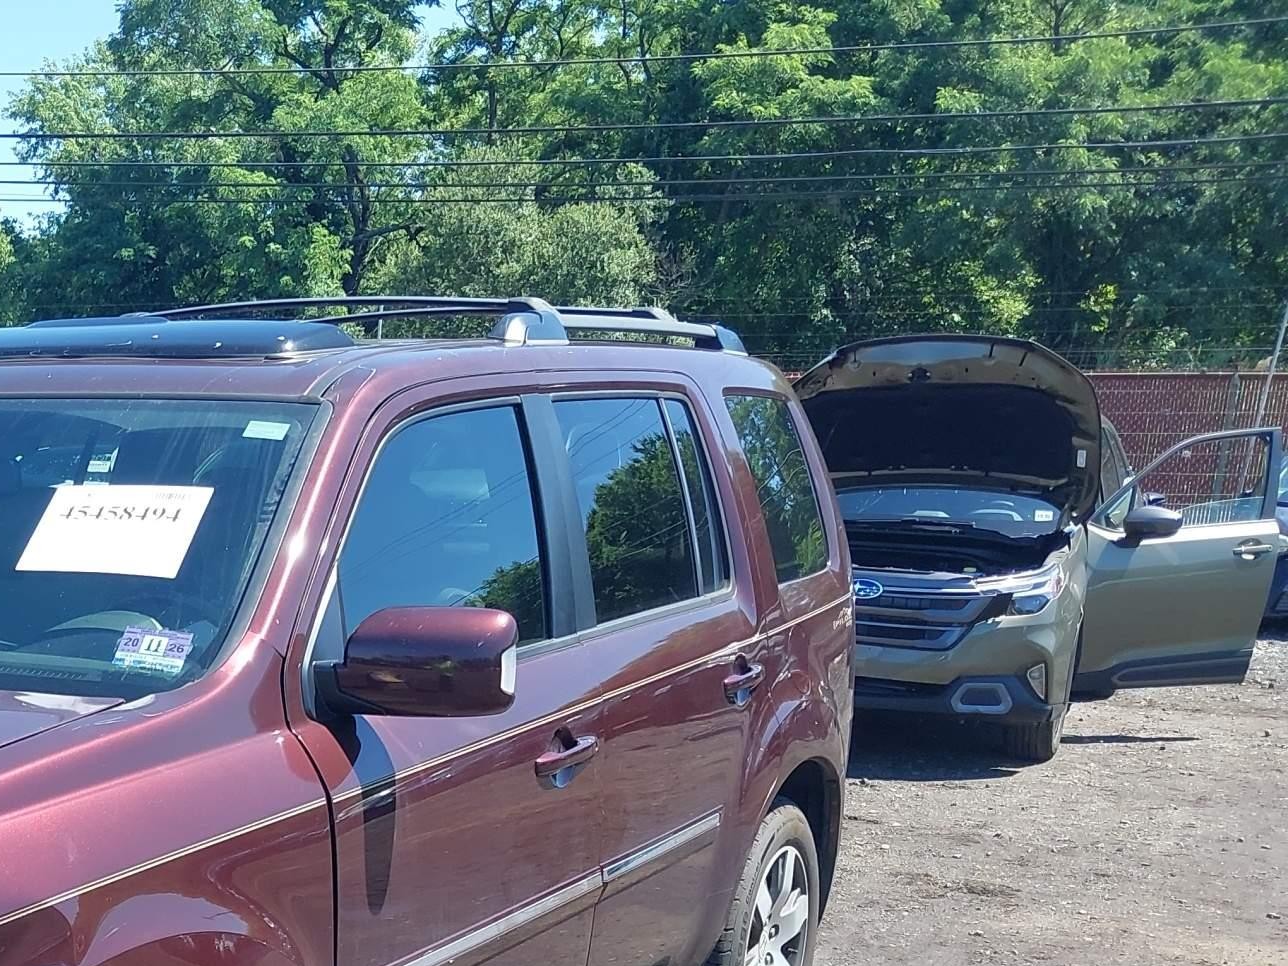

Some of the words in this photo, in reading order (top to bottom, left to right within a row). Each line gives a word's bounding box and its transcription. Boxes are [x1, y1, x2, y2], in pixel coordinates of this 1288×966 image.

[60, 505, 182, 522] 45458494
[123, 637, 140, 648] 20
[144, 637, 163, 653] 11
[168, 643, 185, 654] 26
